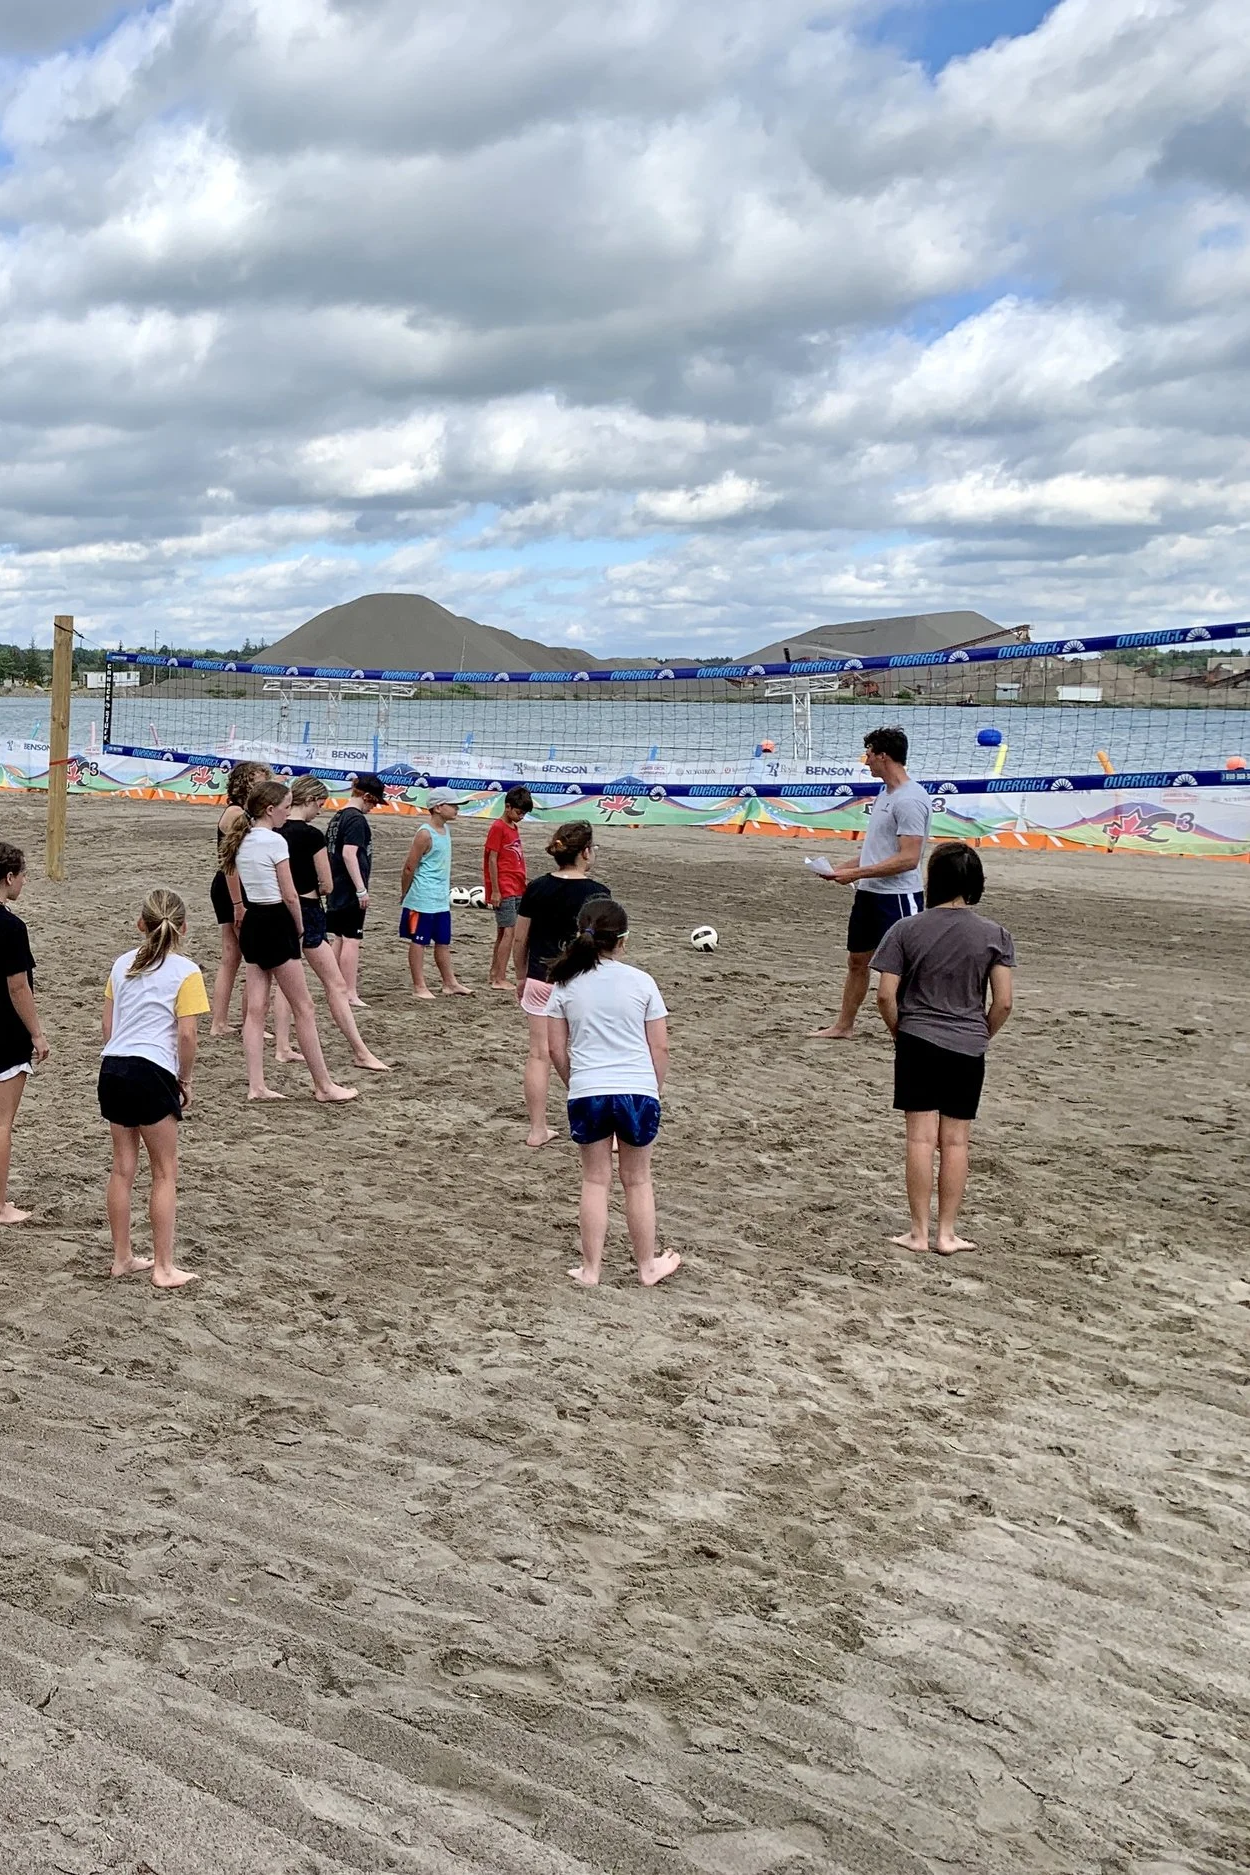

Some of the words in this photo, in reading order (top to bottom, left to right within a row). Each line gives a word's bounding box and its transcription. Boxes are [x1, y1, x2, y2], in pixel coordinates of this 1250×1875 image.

[331, 750, 369, 760] BENSON
[90, 762, 99, 777] 3
[542, 764, 588, 774] BENSON
[805, 766, 855, 776] BENSON
[1176, 812, 1195, 833] 3
